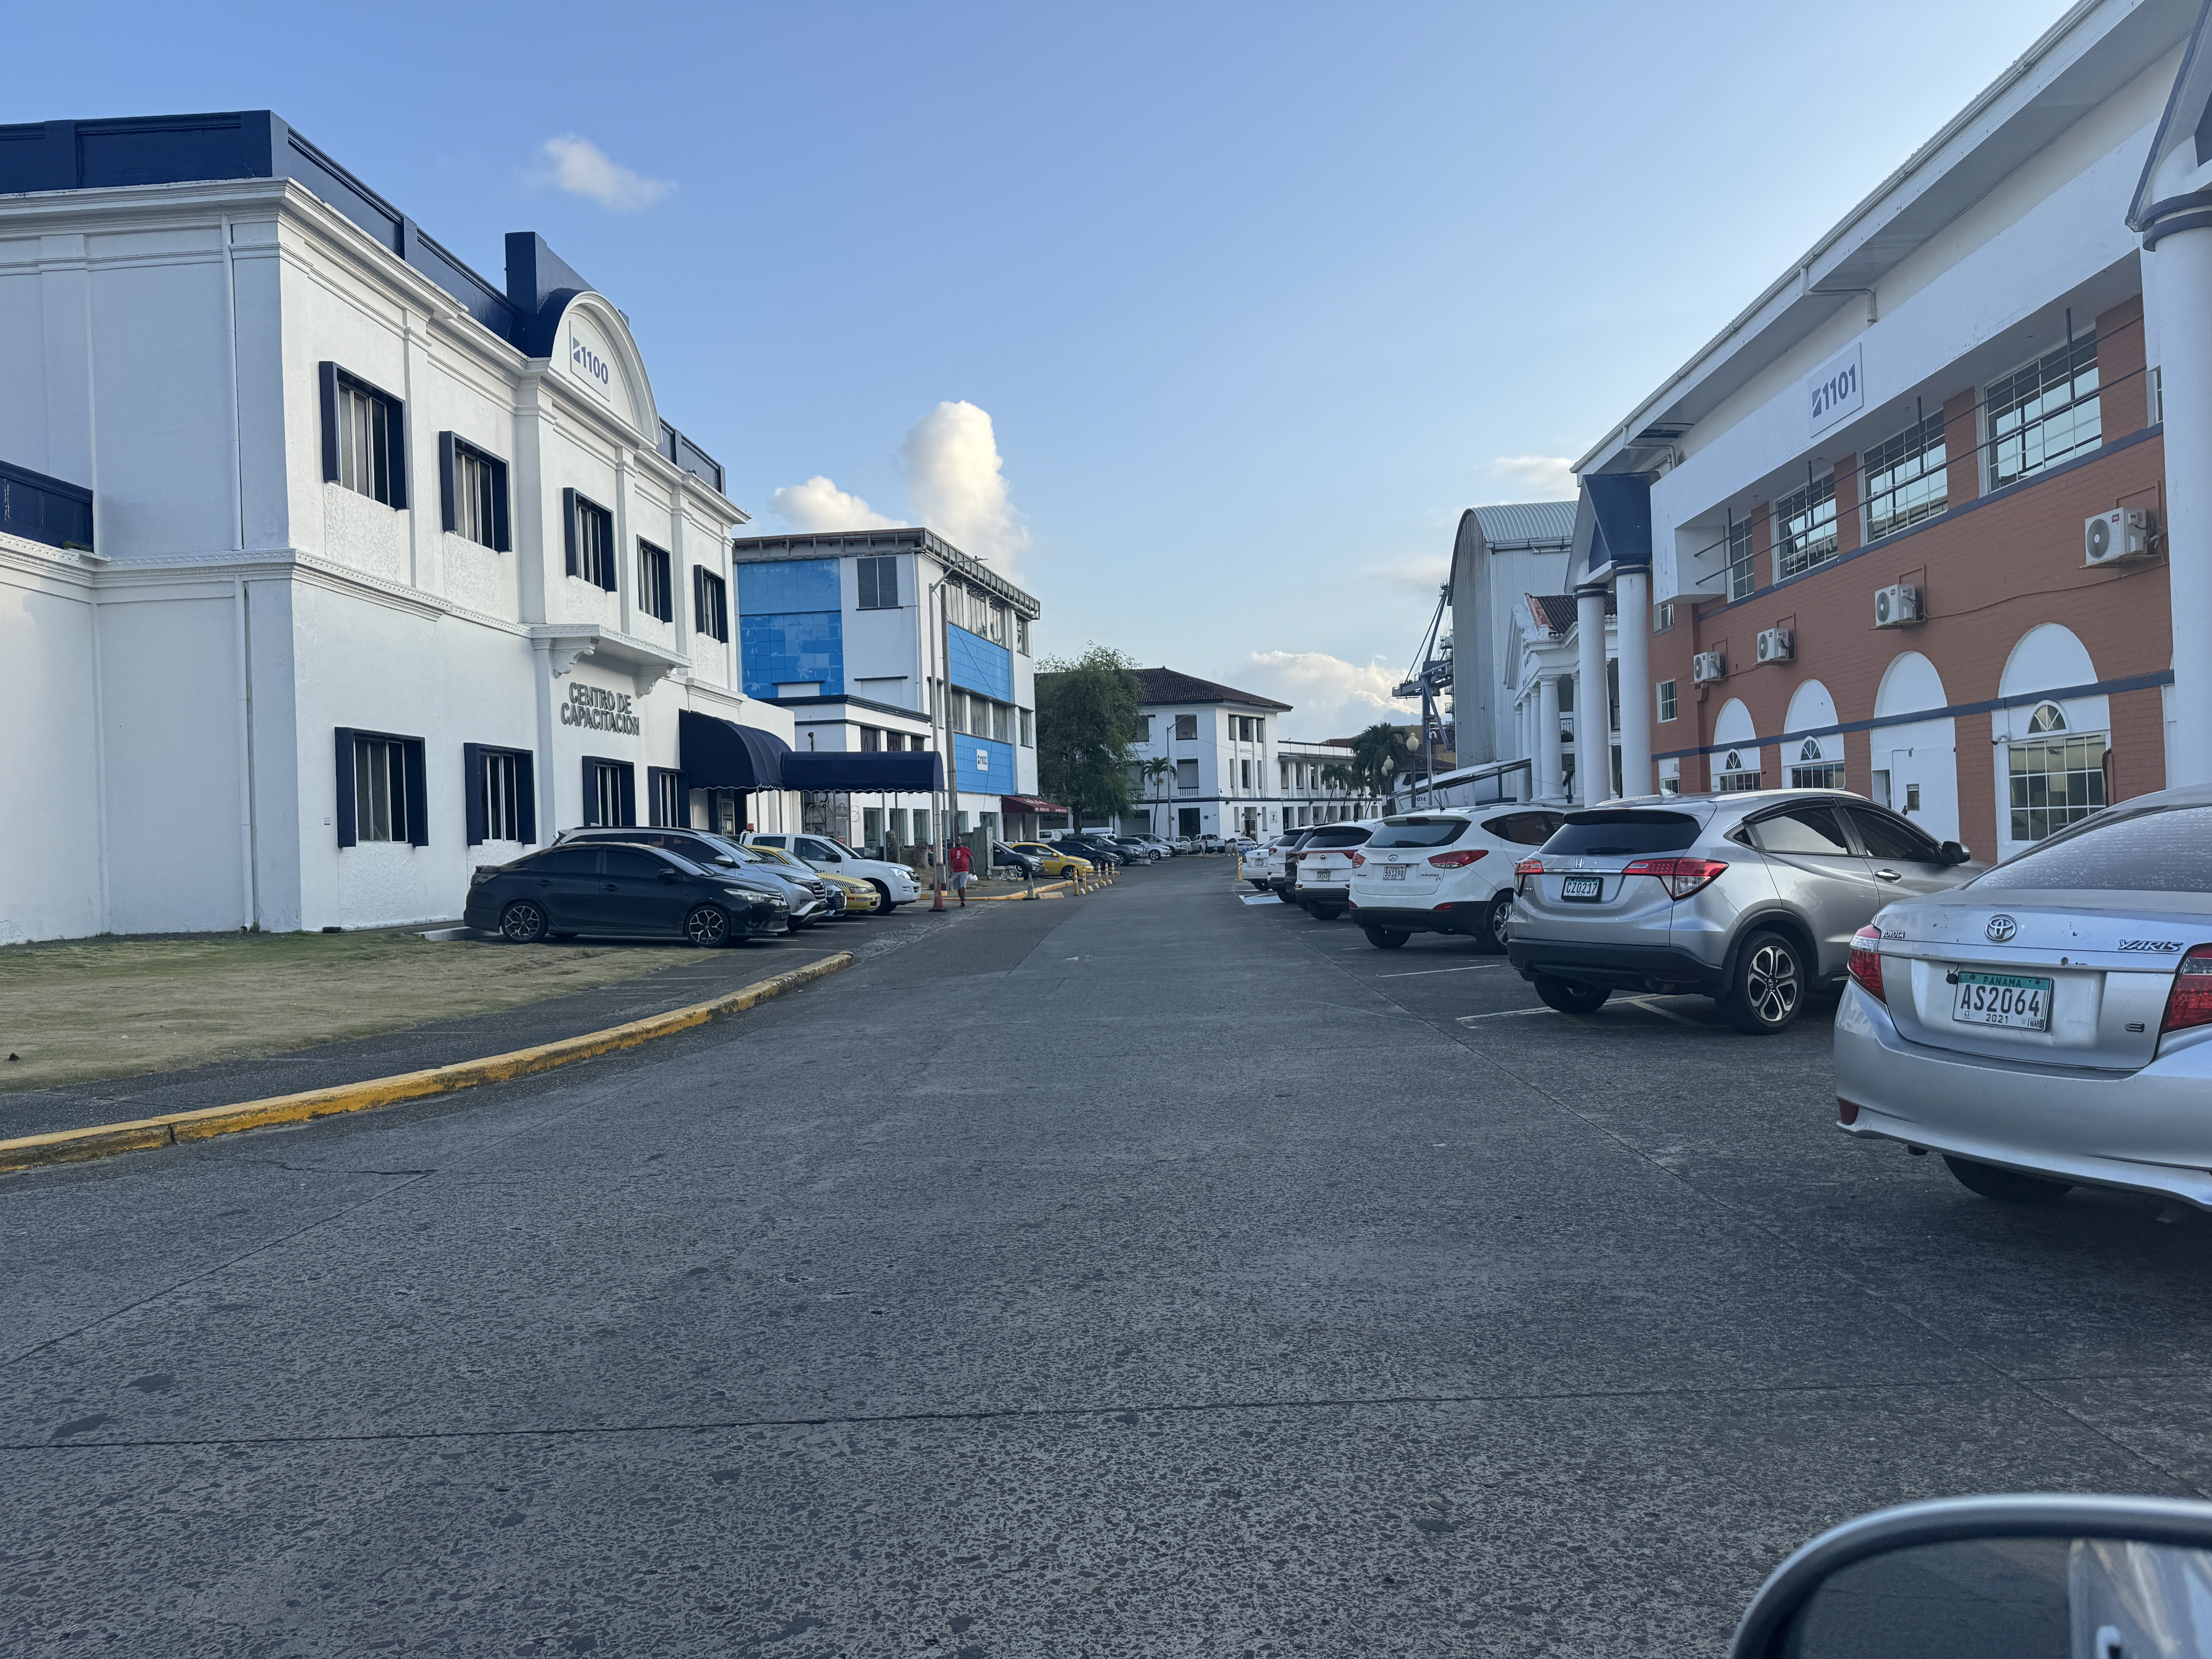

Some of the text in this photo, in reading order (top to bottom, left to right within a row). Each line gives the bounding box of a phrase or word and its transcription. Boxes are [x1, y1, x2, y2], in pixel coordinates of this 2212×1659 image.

[581, 347, 608, 385] 1100
[1822, 363, 1856, 410] 1101
[569, 682, 632, 714] CENTRO DE
[1566, 882, 1597, 894] CZ0217
[1883, 930, 1905, 938] TOYOTA
[2118, 939, 2184, 952] YARIS
[1983, 975, 2021, 988] PANAMA
[1960, 984, 2039, 1017] AS2064
[1986, 1013, 2009, 1024] 2021
